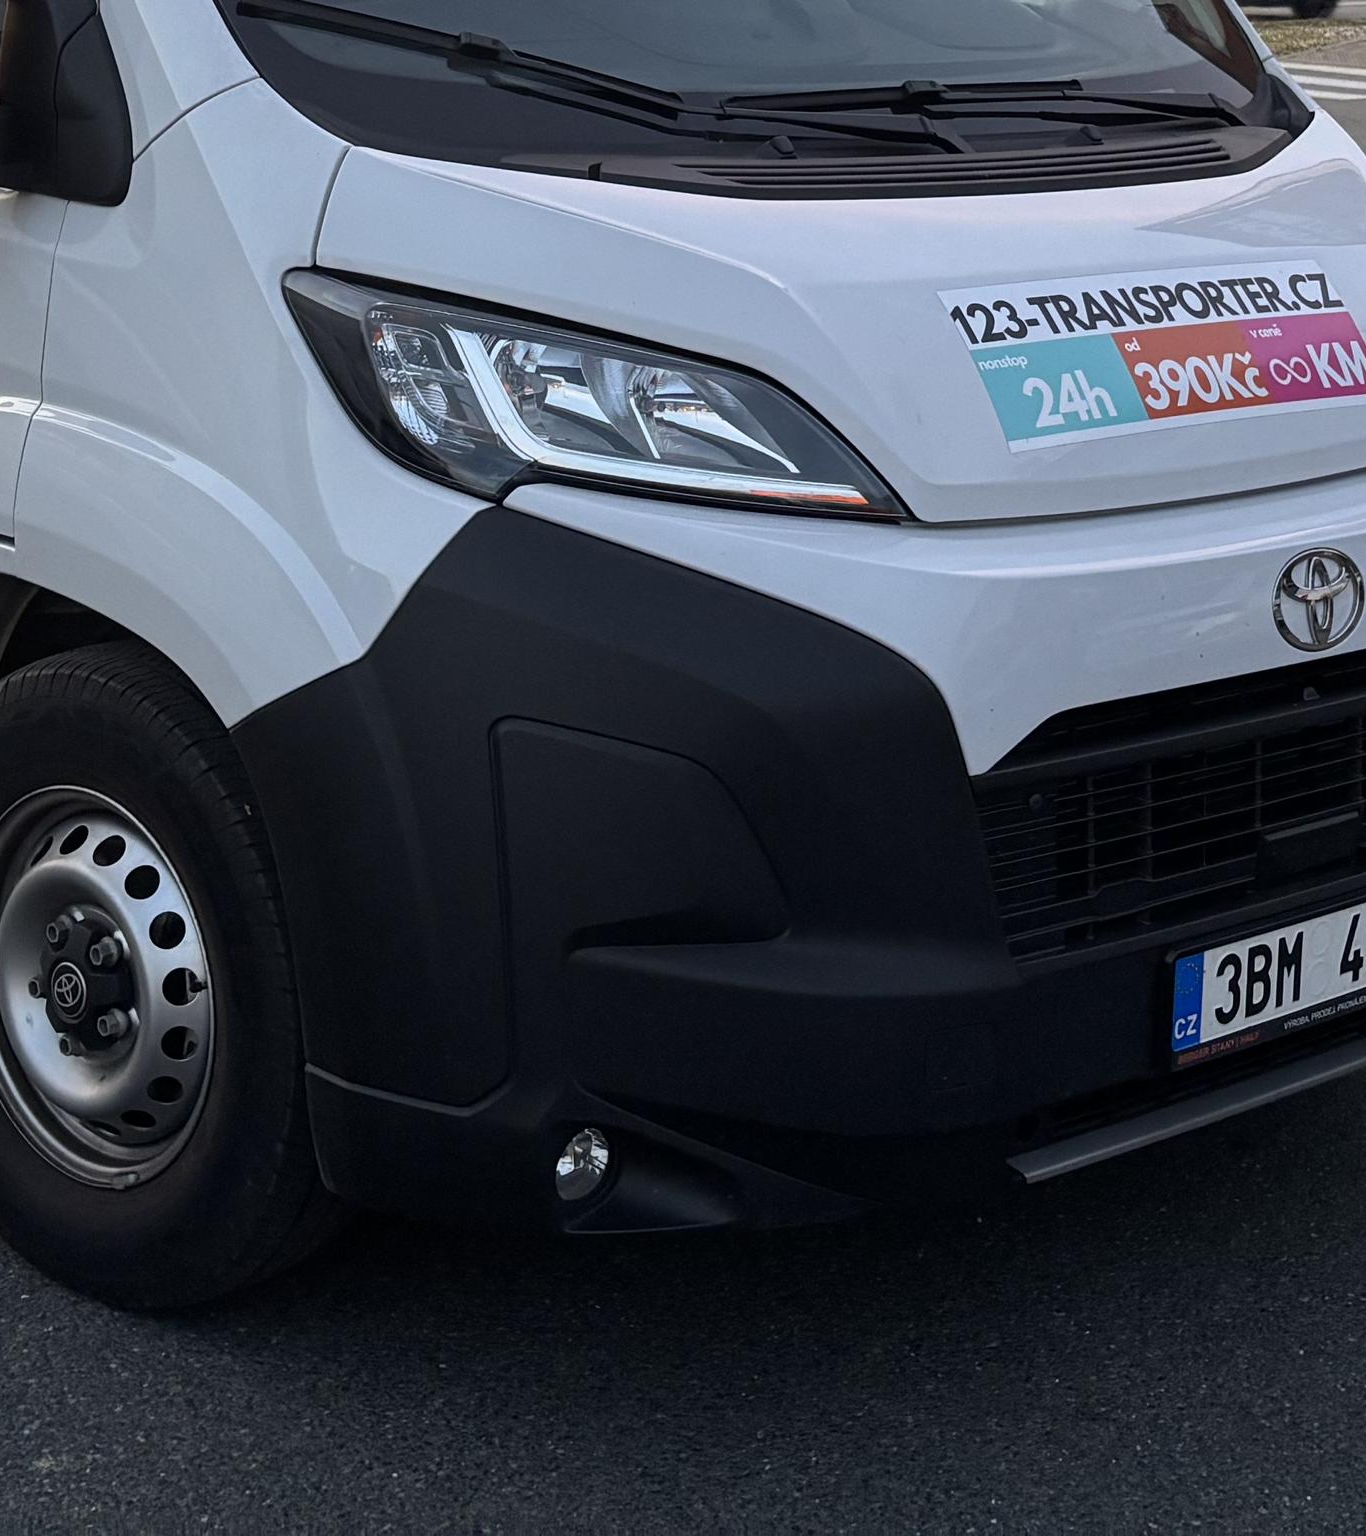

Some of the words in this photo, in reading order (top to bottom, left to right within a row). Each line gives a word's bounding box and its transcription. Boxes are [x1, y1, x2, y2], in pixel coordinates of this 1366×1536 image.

[950, 271, 1344, 346] 123-TRANSPORTER.CZ
[1124, 337, 1141, 353] od
[1259, 324, 1283, 339] ceně
[977, 353, 1028, 371] nonstop
[1134, 352, 1269, 412] 390Kč
[1021, 369, 1117, 429] 24h
[1214, 930, 1304, 1025] 3BM
[1174, 1014, 1197, 1041] CZ
